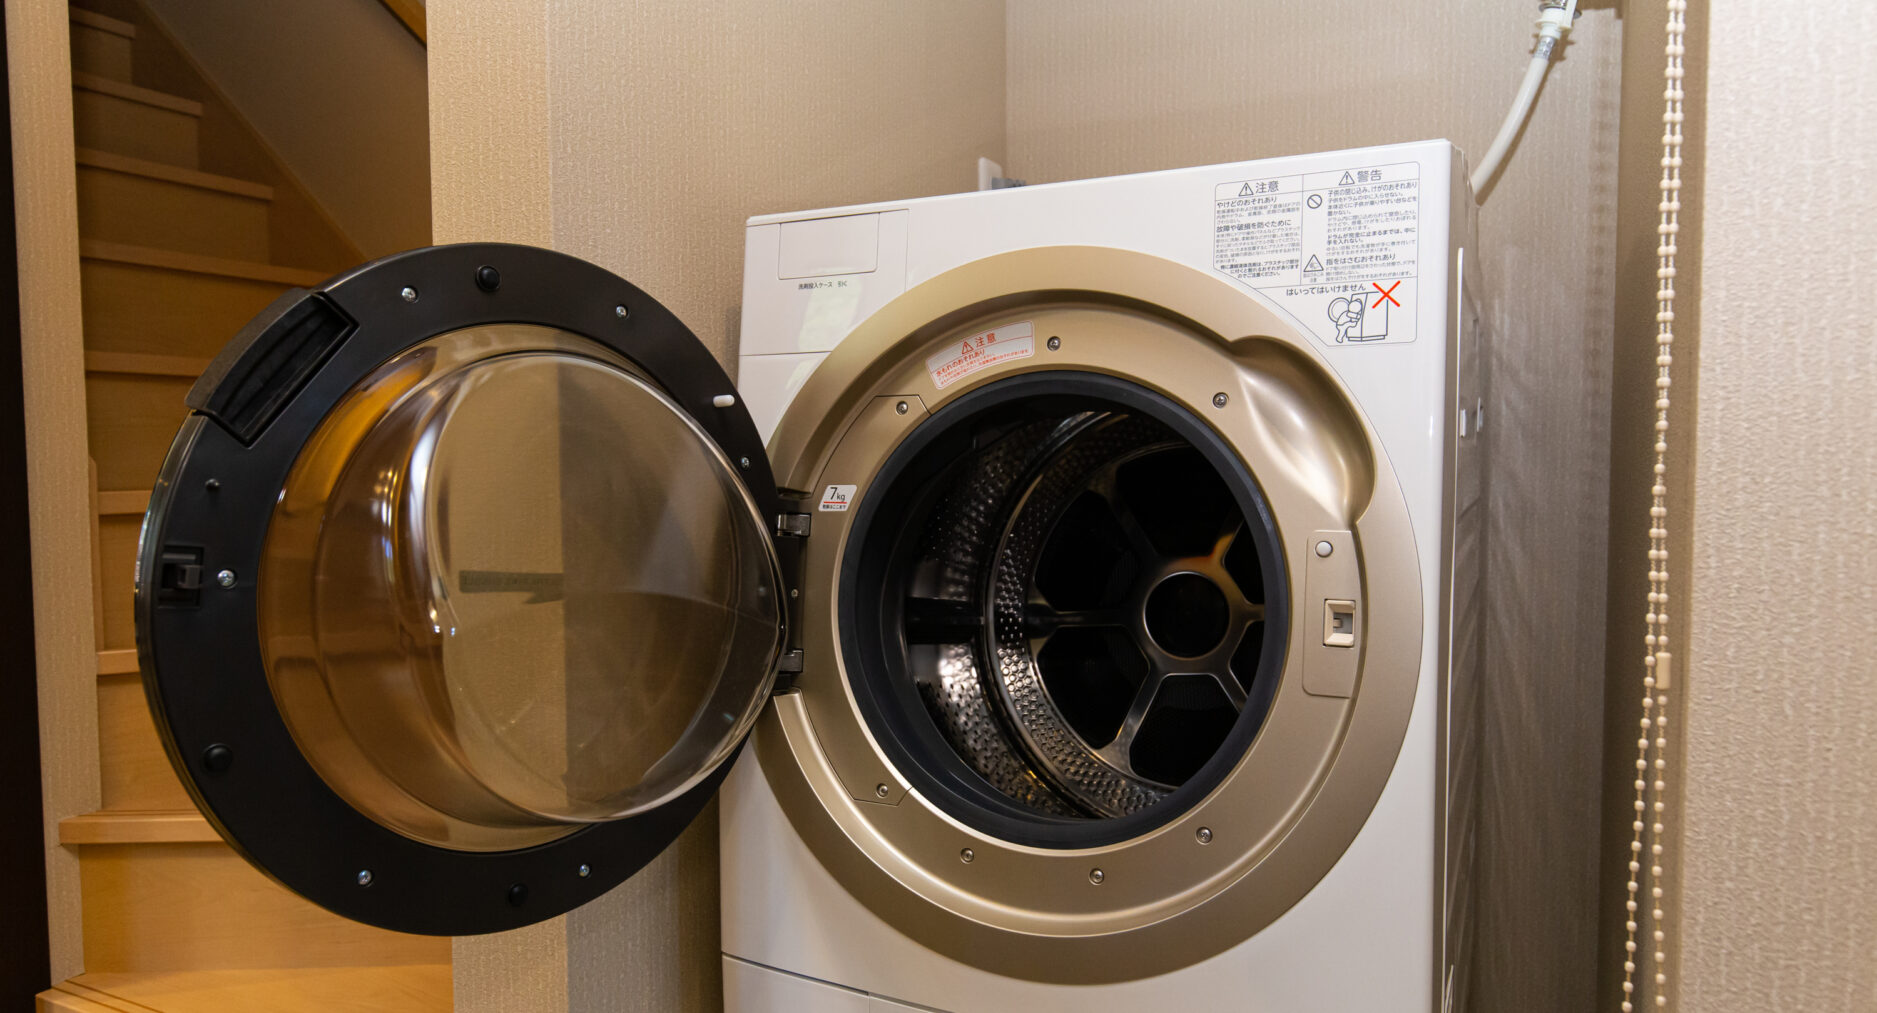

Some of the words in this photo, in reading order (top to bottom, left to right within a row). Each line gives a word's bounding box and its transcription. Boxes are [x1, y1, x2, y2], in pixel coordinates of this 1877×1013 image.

[1357, 169, 1383, 183] 警告
[1255, 180, 1280, 194] 注意
[1216, 196, 1278, 208] やけどのおそれあり
[1325, 253, 1397, 266] 指をはさむおそれあり
[1286, 283, 1367, 297] はいってはいけません
[975, 332, 997, 348] 注意
